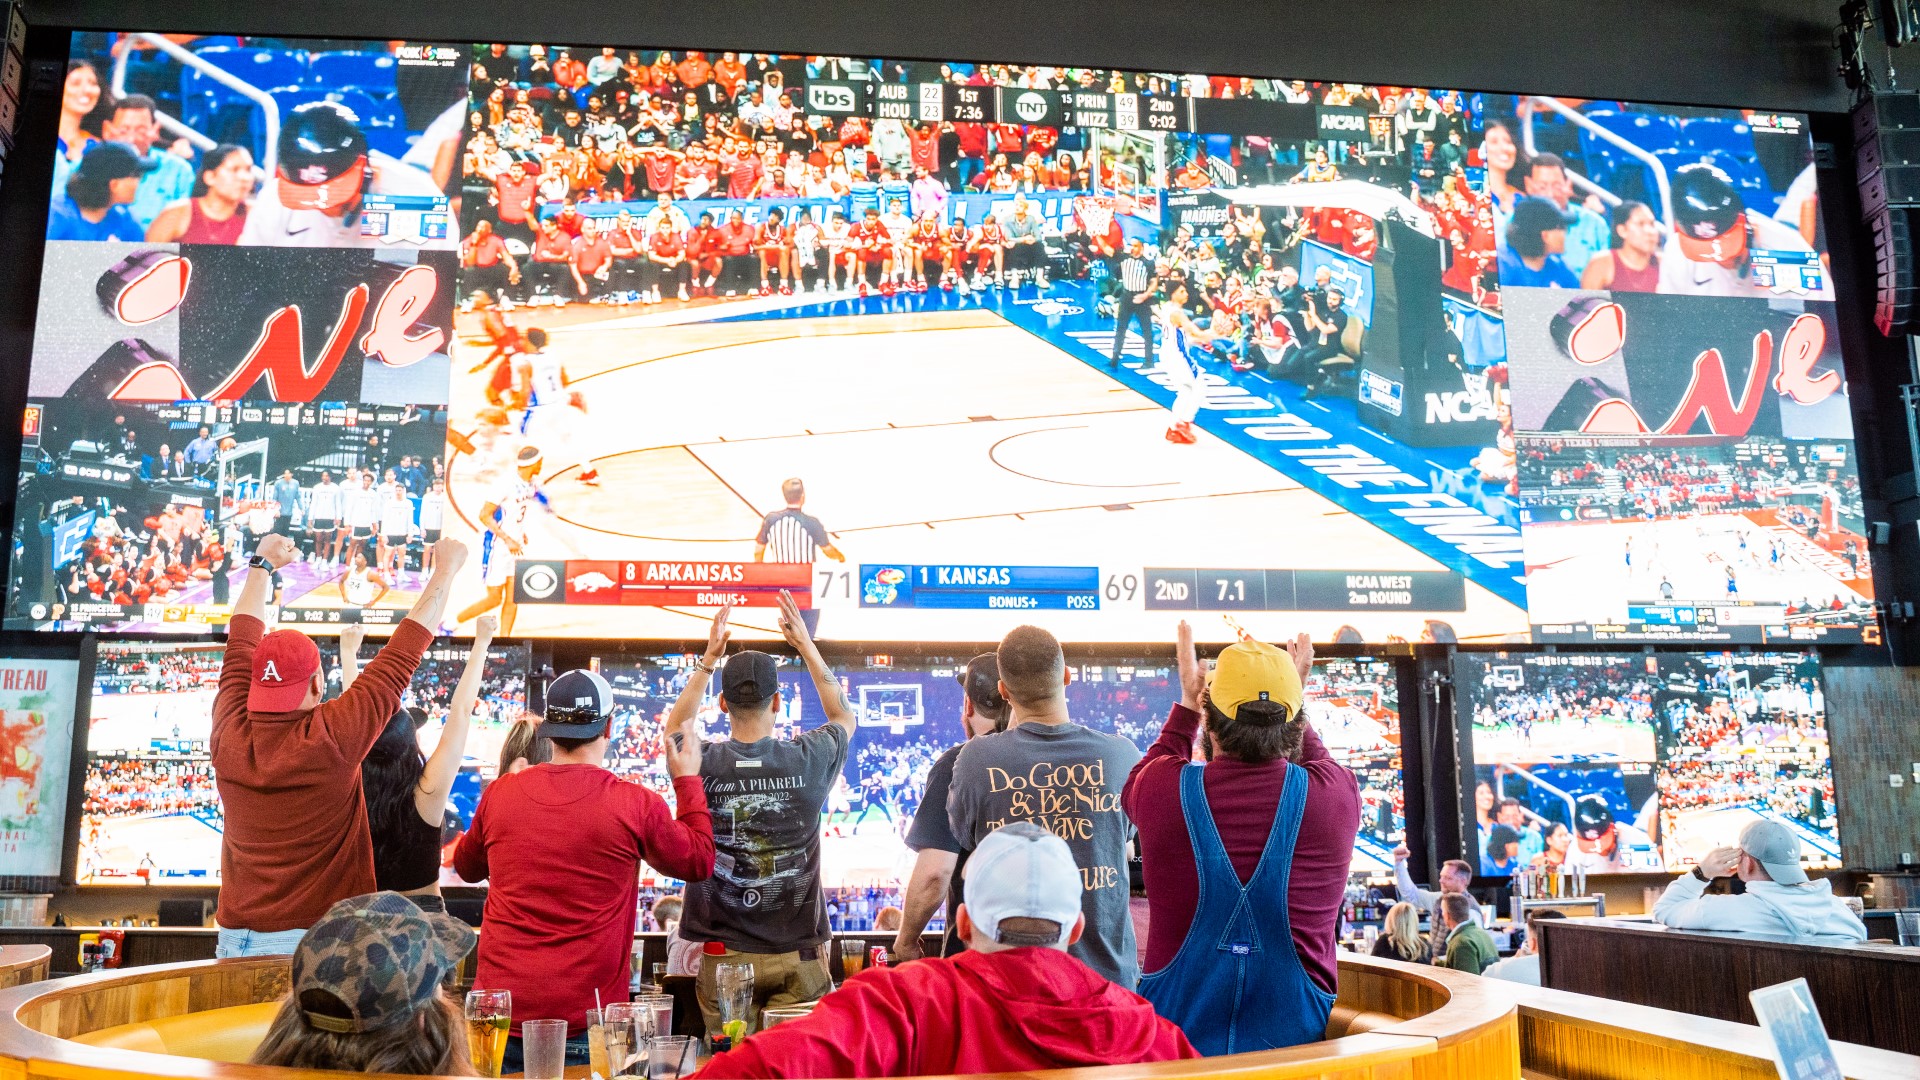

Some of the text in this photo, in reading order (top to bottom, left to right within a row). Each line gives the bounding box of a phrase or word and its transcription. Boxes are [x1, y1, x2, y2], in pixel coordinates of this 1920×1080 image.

[814, 90, 851, 106] tbs
[866, 84, 938, 100] 9 AUB 22
[958, 88, 978, 103] 1ST
[1016, 102, 1048, 114] TNT
[1061, 94, 1133, 109] 15 PRIN 49
[1150, 98, 1174, 112] 2ND
[866, 103, 939, 118] 1 HOU 23
[954, 106, 983, 120] 7:36
[1064, 112, 1135, 128] 7 MIZZ 39
[1149, 115, 1177, 129] 9:02
[1320, 114, 1366, 131] NCAA
[1181, 209, 1228, 223] MADNES
[1565, 439, 1592, 447] TEXAS
[1280, 444, 1429, 489] THE
[1364, 493, 1523, 569] FINAL
[626, 563, 743, 582] 8 ARKANSAS
[920, 567, 1011, 586] 1 KANSAS
[818, 571, 851, 599] 71
[1105, 574, 1138, 601] 69
[1154, 579, 1245, 601] 2ND 7.1
[1346, 575, 1412, 590] NCAA WEST
[697, 593, 748, 606] BONUS+
[988, 596, 1095, 609] BONUS+ POSS
[1369, 591, 1412, 604] ROUND
[304, 611, 324, 622] 9:02
[328, 612, 340, 621] 30
[261, 660, 282, 682] A
[739, 779, 747, 791] X
[750, 775, 806, 791] PHARELL
[986, 759, 1106, 793] Do Good
[1009, 786, 1122, 816] & Be Nice
[1078, 866, 1117, 890] ure
[748, 893, 756, 904] P
